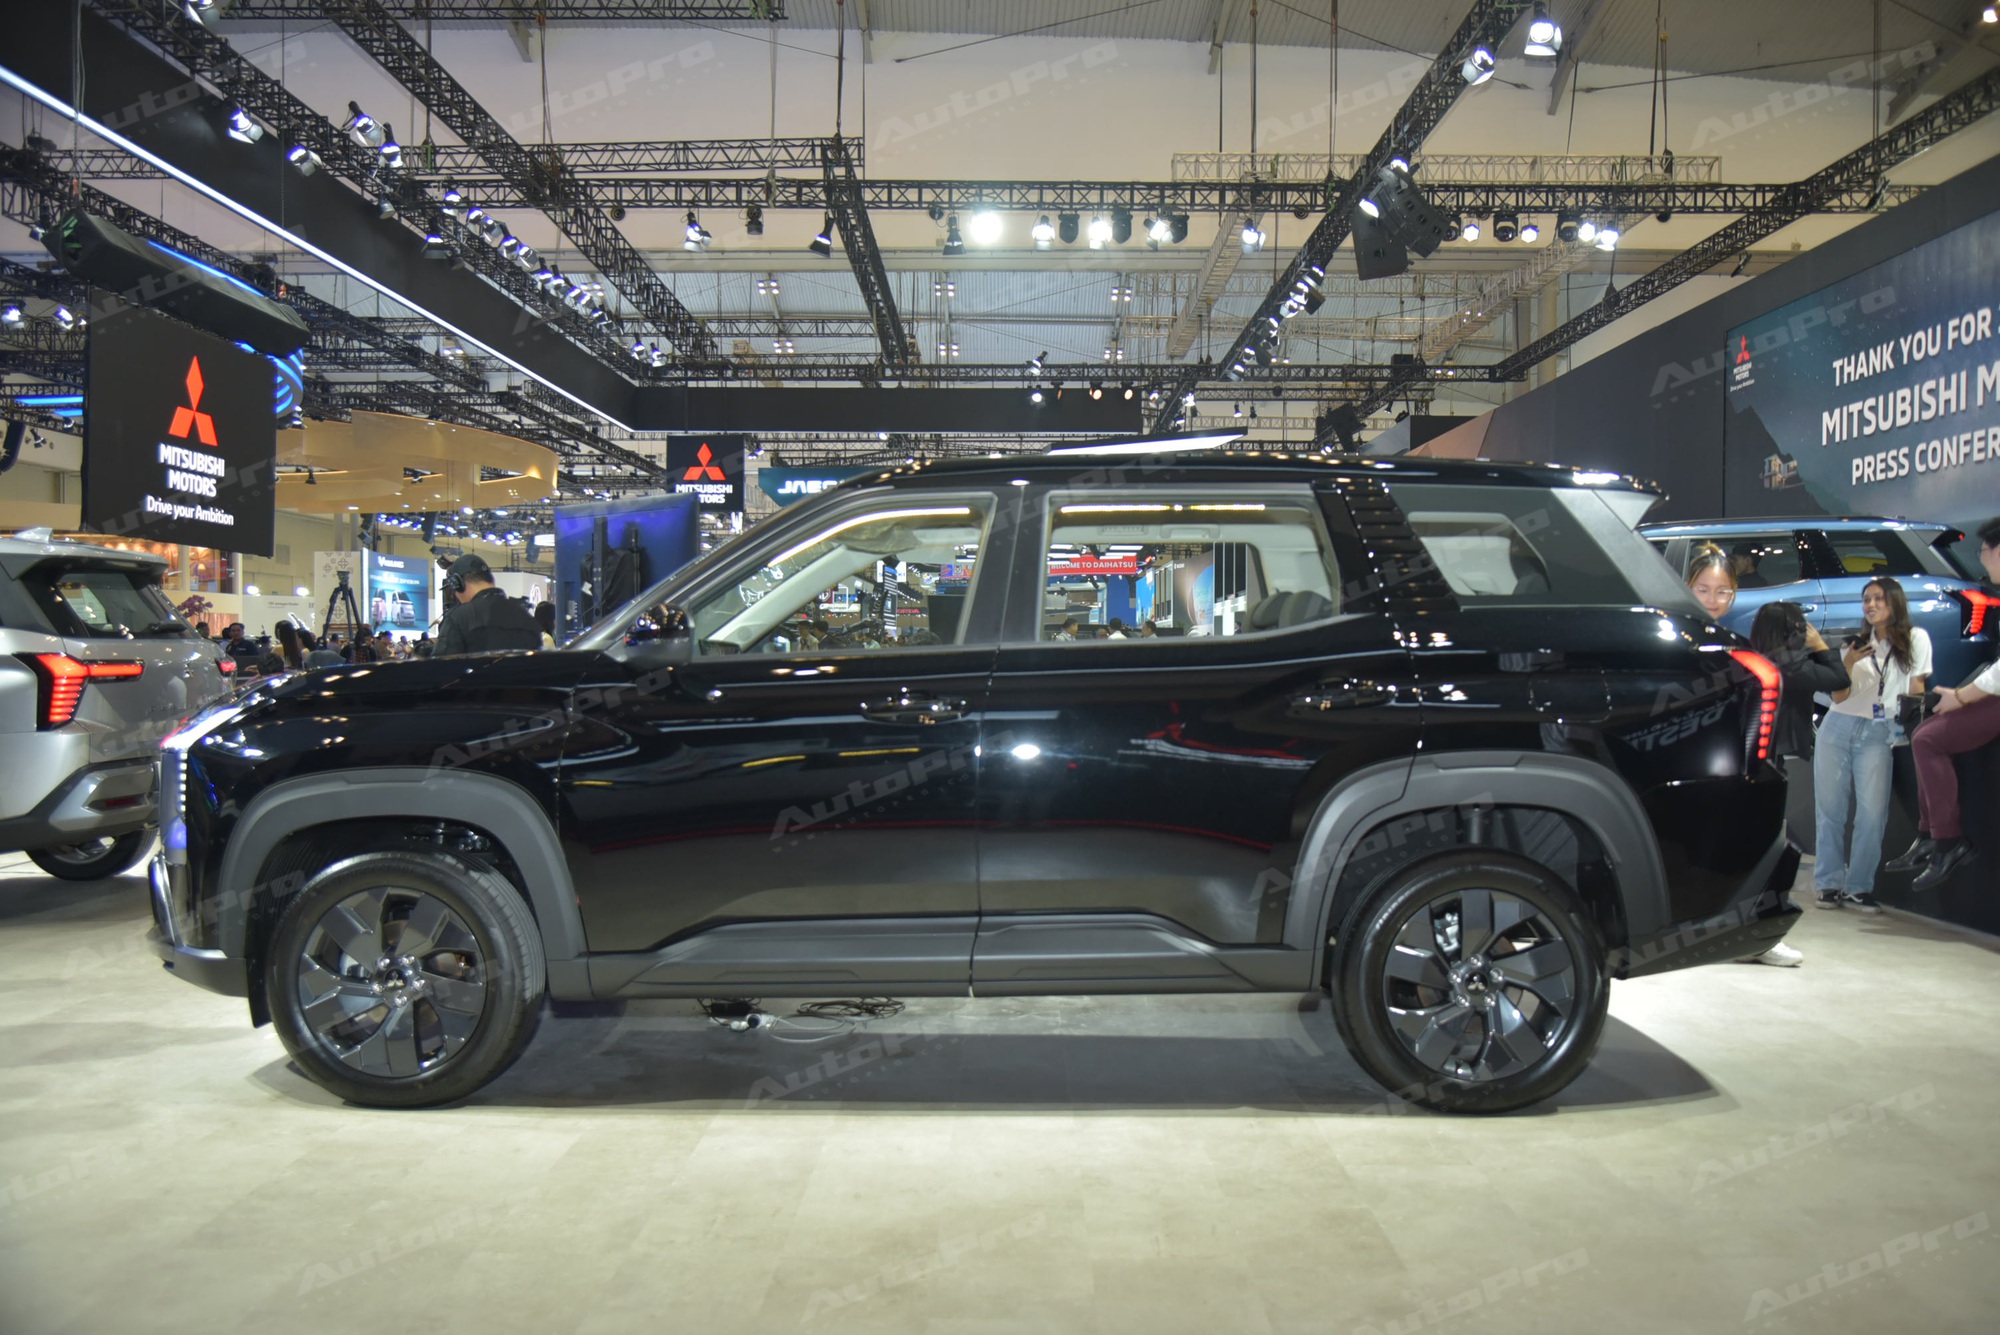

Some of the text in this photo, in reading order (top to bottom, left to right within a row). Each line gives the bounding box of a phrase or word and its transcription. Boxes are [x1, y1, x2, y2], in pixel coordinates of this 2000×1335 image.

[1833, 307, 1992, 387] THANK YOU FOR
[1822, 370, 1968, 446] MITSUBISHI
[158, 443, 225, 477] MITSUBISHI
[1852, 426, 2000, 486] PRESS CONFER
[167, 468, 217, 497] MOTORS
[675, 484, 733, 494] MITSUBISHI
[145, 495, 234, 525] Drive your Ambition
[698, 494, 726, 504] TORS
